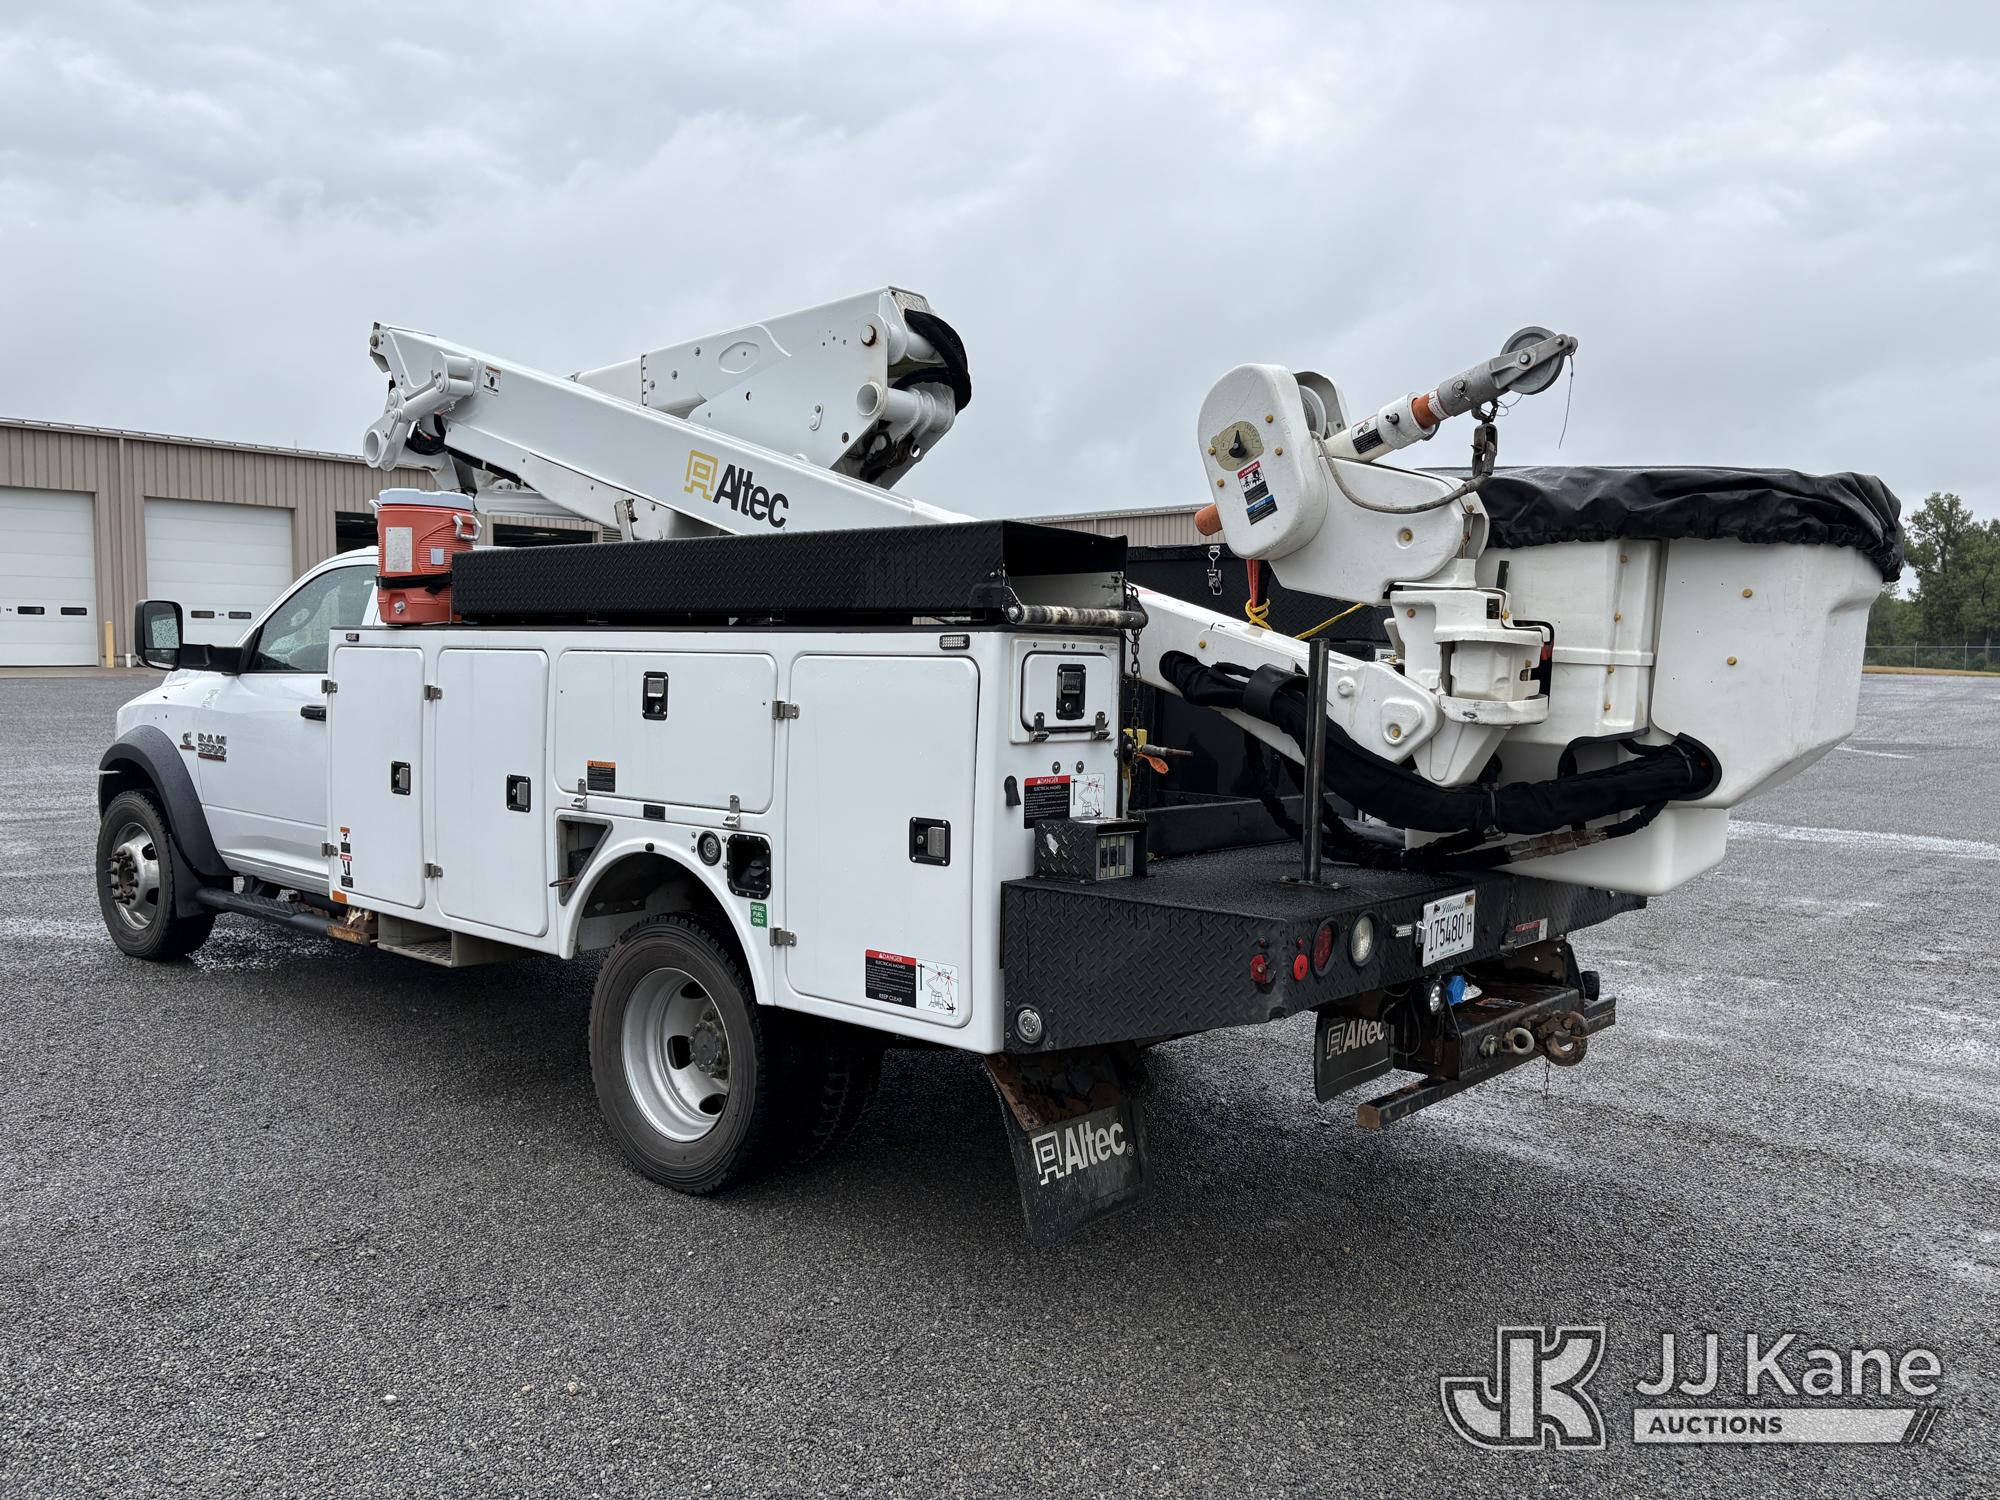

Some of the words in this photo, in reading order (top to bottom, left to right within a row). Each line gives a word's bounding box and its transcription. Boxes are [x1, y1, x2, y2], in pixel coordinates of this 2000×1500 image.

[712, 463, 789, 528] Altec
[197, 733, 227, 746] RAM
[1428, 912, 1465, 952] 175480
[1466, 913, 1473, 934] H
[882, 953, 903, 963] DANGER
[1065, 1121, 1126, 1175] Altec
